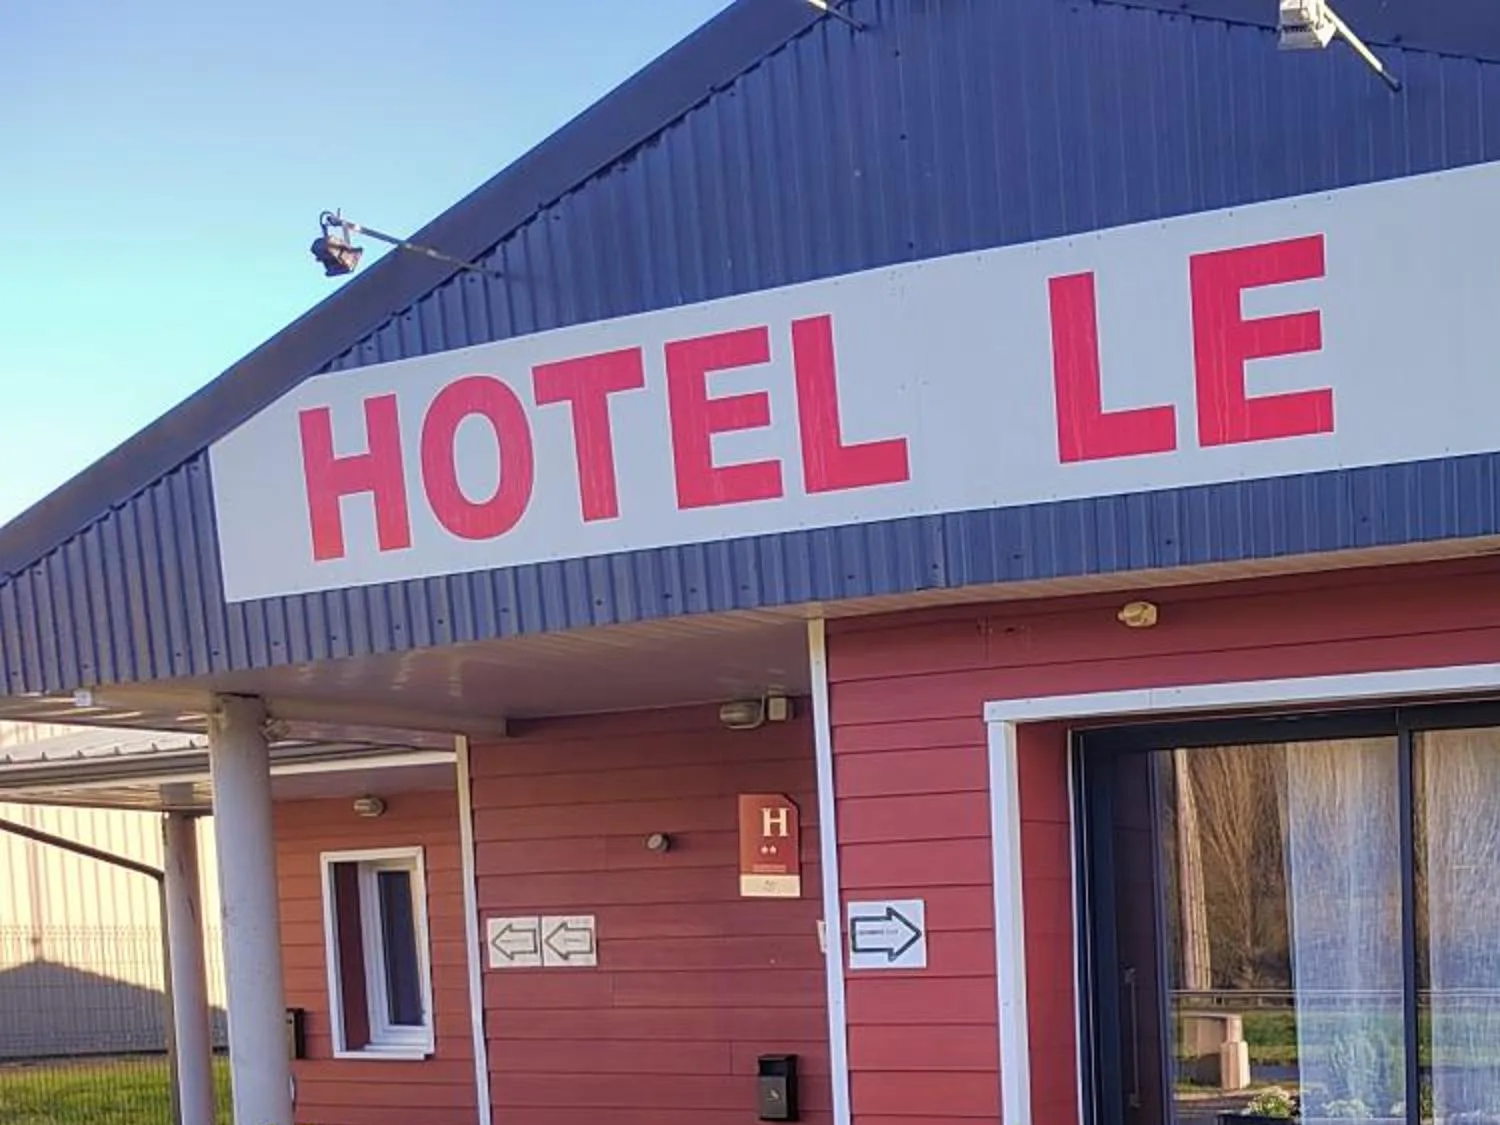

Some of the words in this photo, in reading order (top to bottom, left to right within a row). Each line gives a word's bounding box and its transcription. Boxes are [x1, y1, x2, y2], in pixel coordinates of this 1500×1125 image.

[299, 314, 909, 561] HOTEL
[1048, 234, 1334, 463] LE
[760, 807, 790, 836] H
